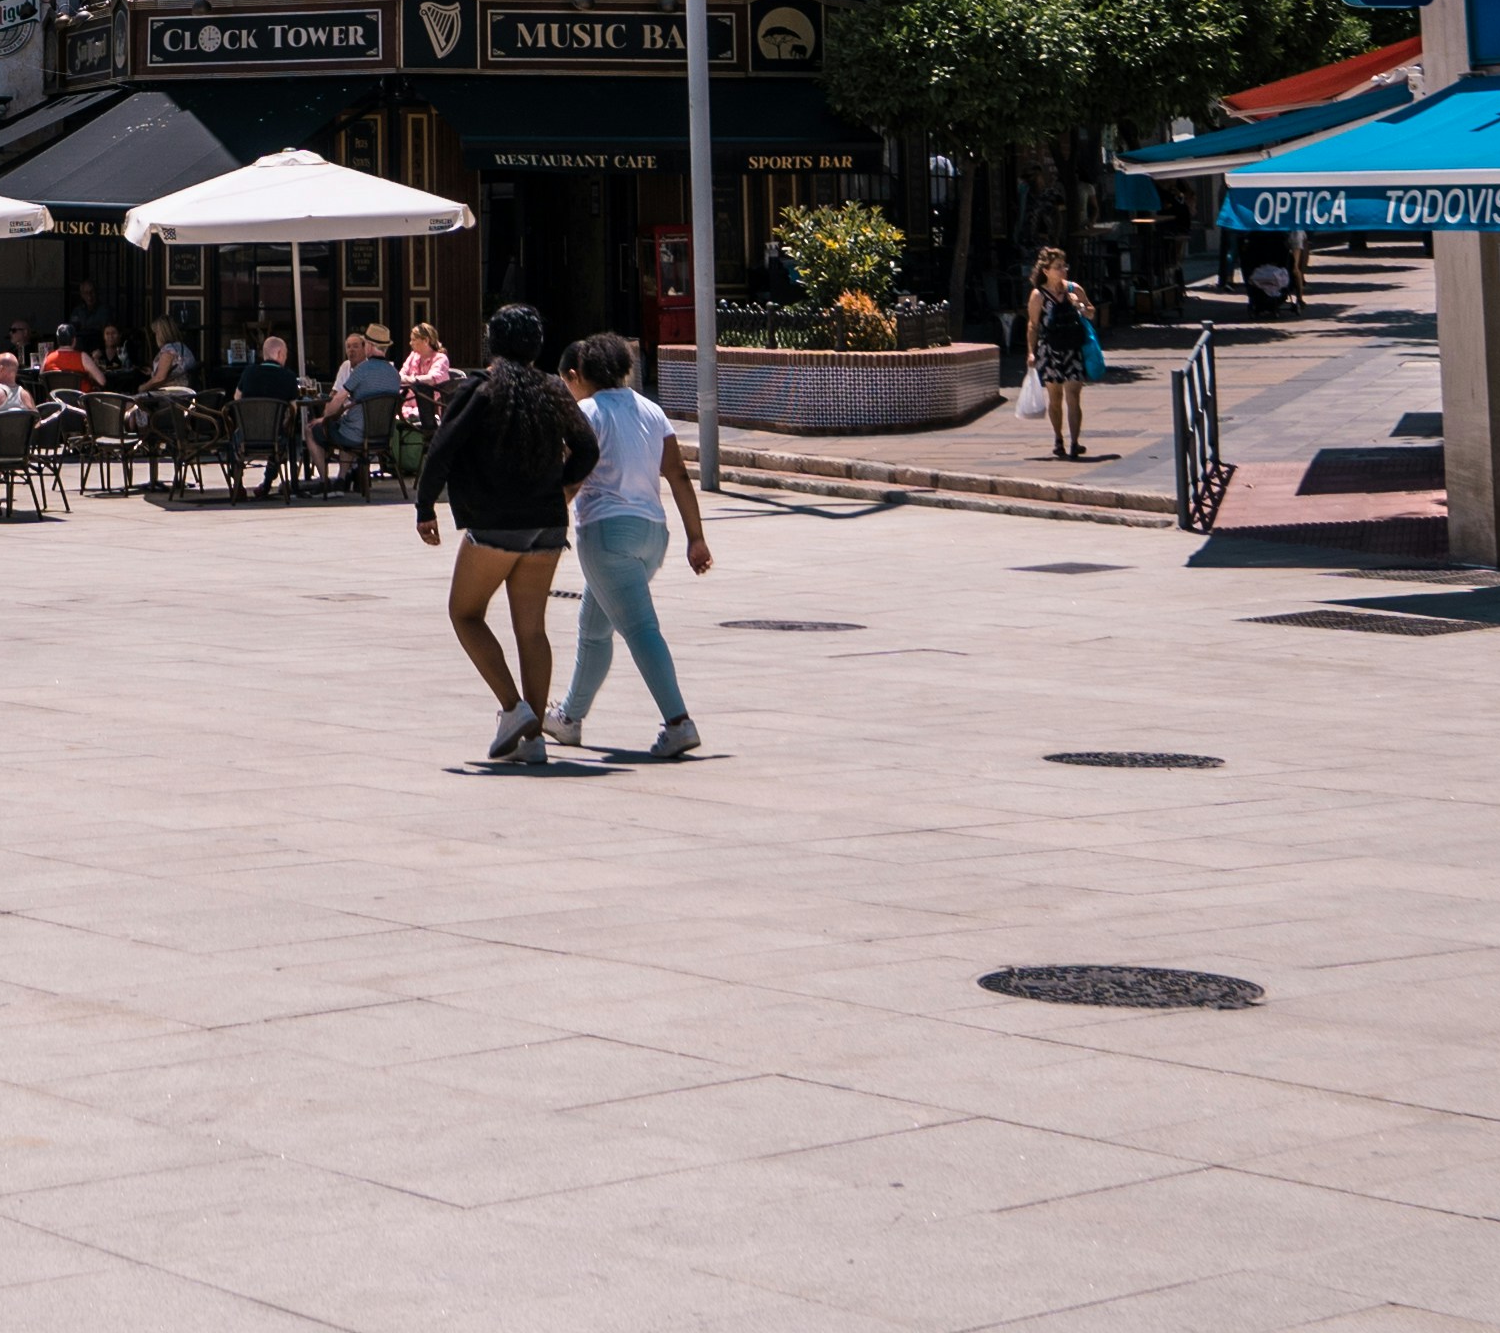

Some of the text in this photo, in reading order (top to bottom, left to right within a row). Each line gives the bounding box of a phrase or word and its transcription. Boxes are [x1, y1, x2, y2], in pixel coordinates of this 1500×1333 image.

[163, 24, 367, 52] CLOCK TOWER
[516, 22, 688, 50] MUSIC BA
[495, 153, 657, 169] RESTAURANT CAFE
[748, 154, 853, 170] SPORTS BAR
[1254, 188, 1347, 226] OPTICA
